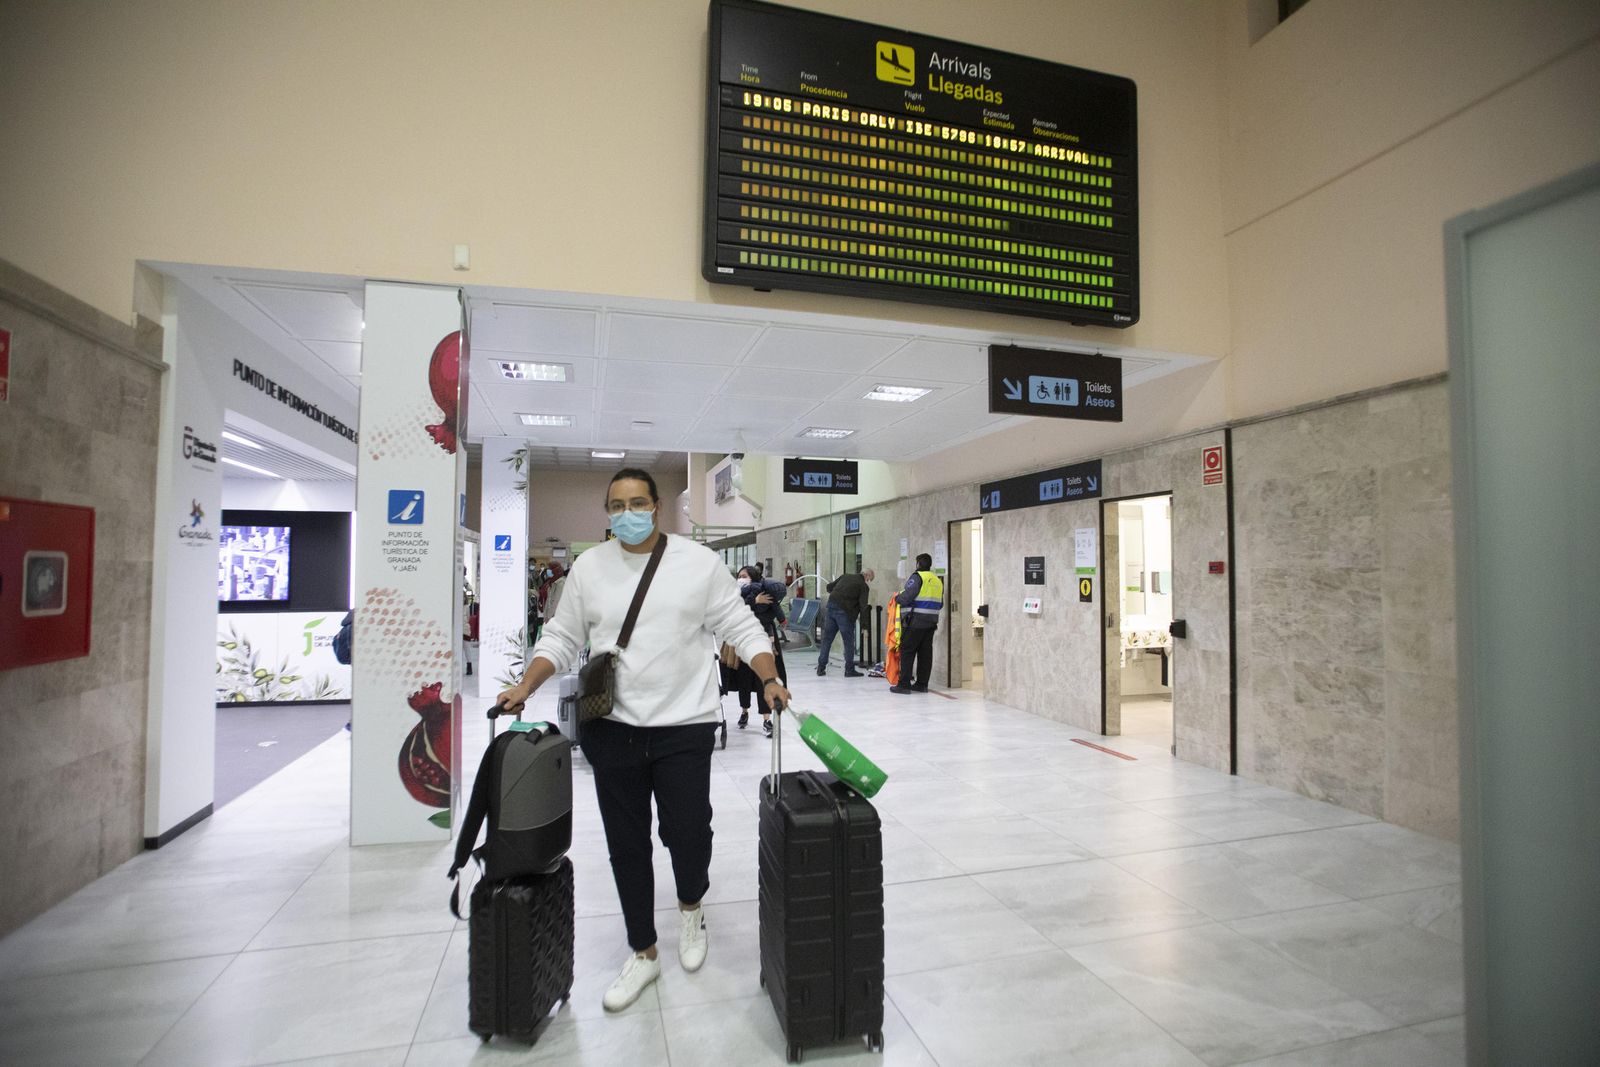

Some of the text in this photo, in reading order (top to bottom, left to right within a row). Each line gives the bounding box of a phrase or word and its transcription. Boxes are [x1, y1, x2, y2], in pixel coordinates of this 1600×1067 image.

[741, 64, 759, 74] Time
[928, 51, 992, 81] Arrivals
[740, 72, 760, 84] Hora
[800, 71, 818, 81] From
[800, 83, 848, 99] Procedencia
[904, 90, 922, 101] Flight
[928, 73, 1004, 105] Llegadas
[904, 102, 925, 113] Vuelo
[983, 108, 1010, 121] Expected
[983, 117, 1015, 130] Estimada
[1032, 118, 1058, 129] Remarks
[802, 102, 850, 122] PARIS
[860, 112, 896, 130] ORLY
[906, 120, 932, 136] IBE
[1034, 144, 1090, 165] ARRIVAL
[1033, 127, 1080, 143] Observaciones
[233, 358, 265, 391] PUNTO
[265, 378, 278, 400] DE
[277, 386, 321, 424] INFORMACIÓN
[1085, 381, 1112, 394] Toilets
[1085, 394, 1115, 408] Aseos
[382, 539, 429, 547] INFORMACIÓN
[399, 564, 417, 572] JAÉN
